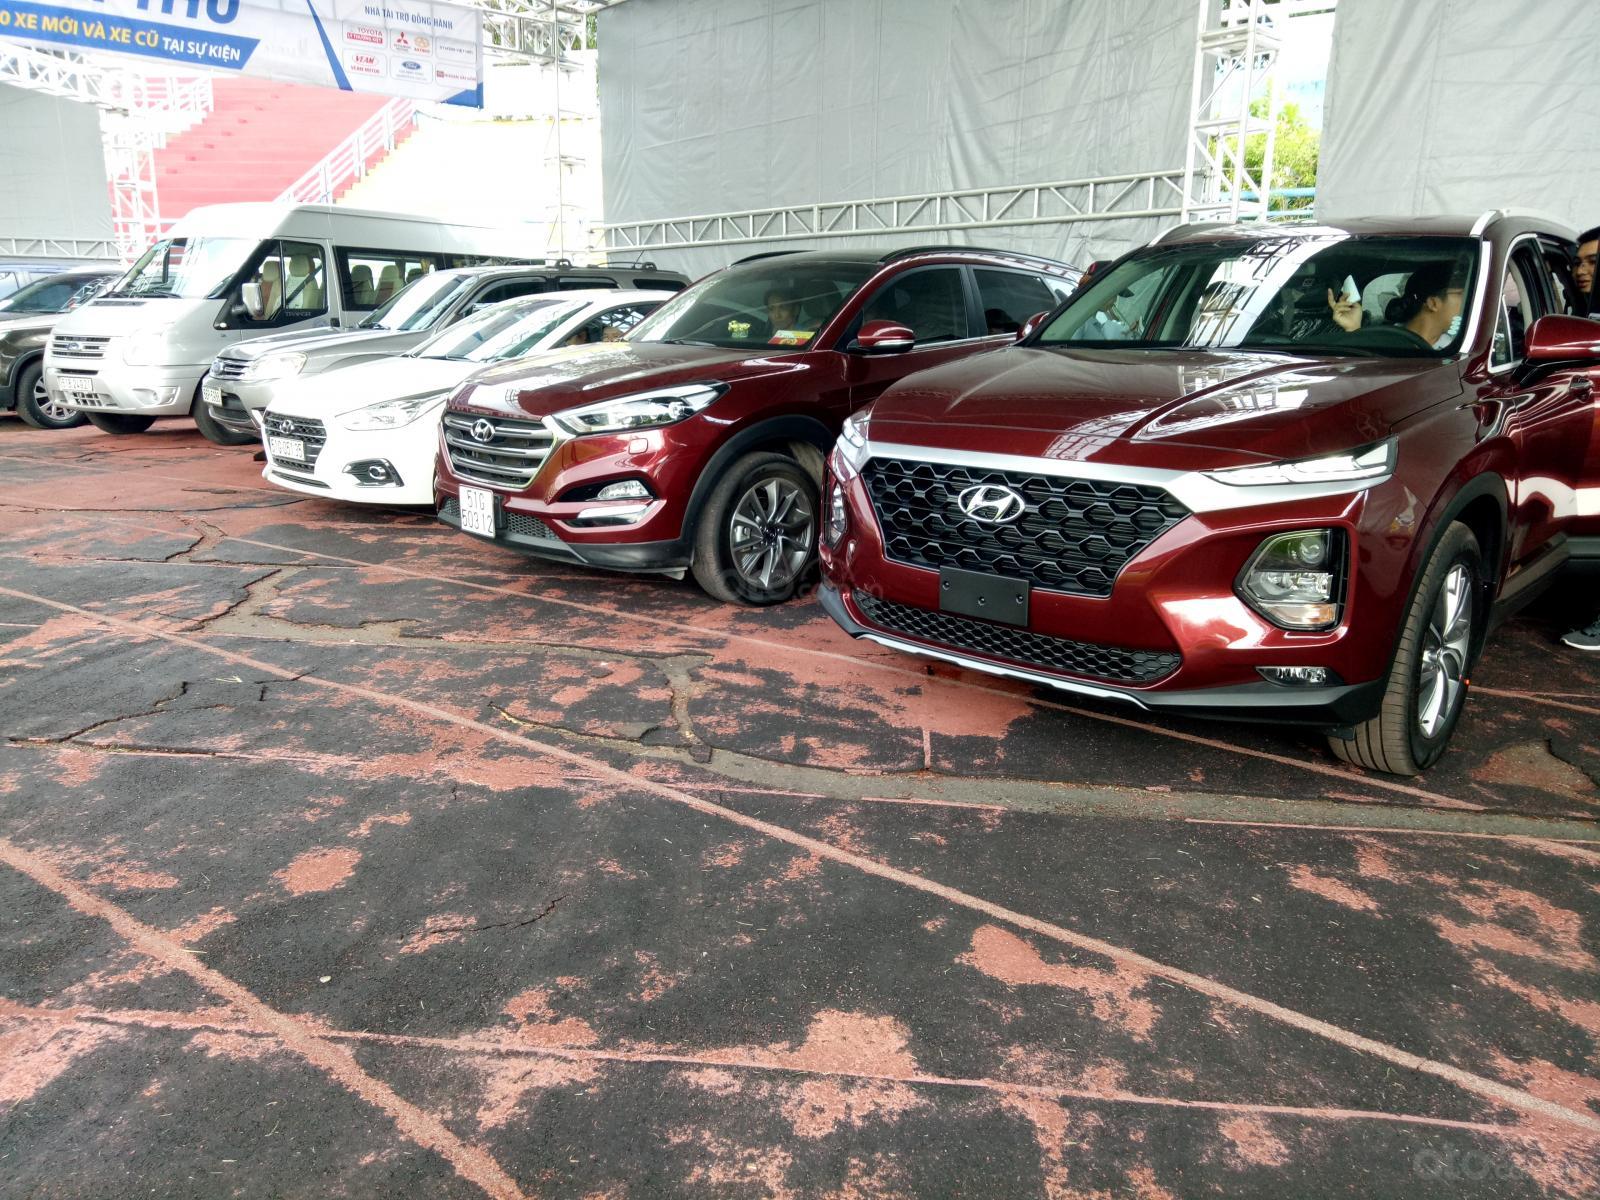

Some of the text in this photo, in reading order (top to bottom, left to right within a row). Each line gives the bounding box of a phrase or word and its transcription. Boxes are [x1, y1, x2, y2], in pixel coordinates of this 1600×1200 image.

[382, 8, 394, 18] TÀI
[14, 11, 37, 30] XE
[41, 15, 79, 35] MỚI
[82, 20, 106, 40] VÀ
[108, 26, 131, 44] XE
[134, 29, 159, 48] CŨ
[162, 36, 185, 55] TẠI
[187, 41, 208, 58] SỰ
[208, 44, 241, 63] KIỆN
[357, 27, 383, 37] TOYOTA
[466, 489, 485, 510] 51G
[461, 508, 494, 534] 50312
